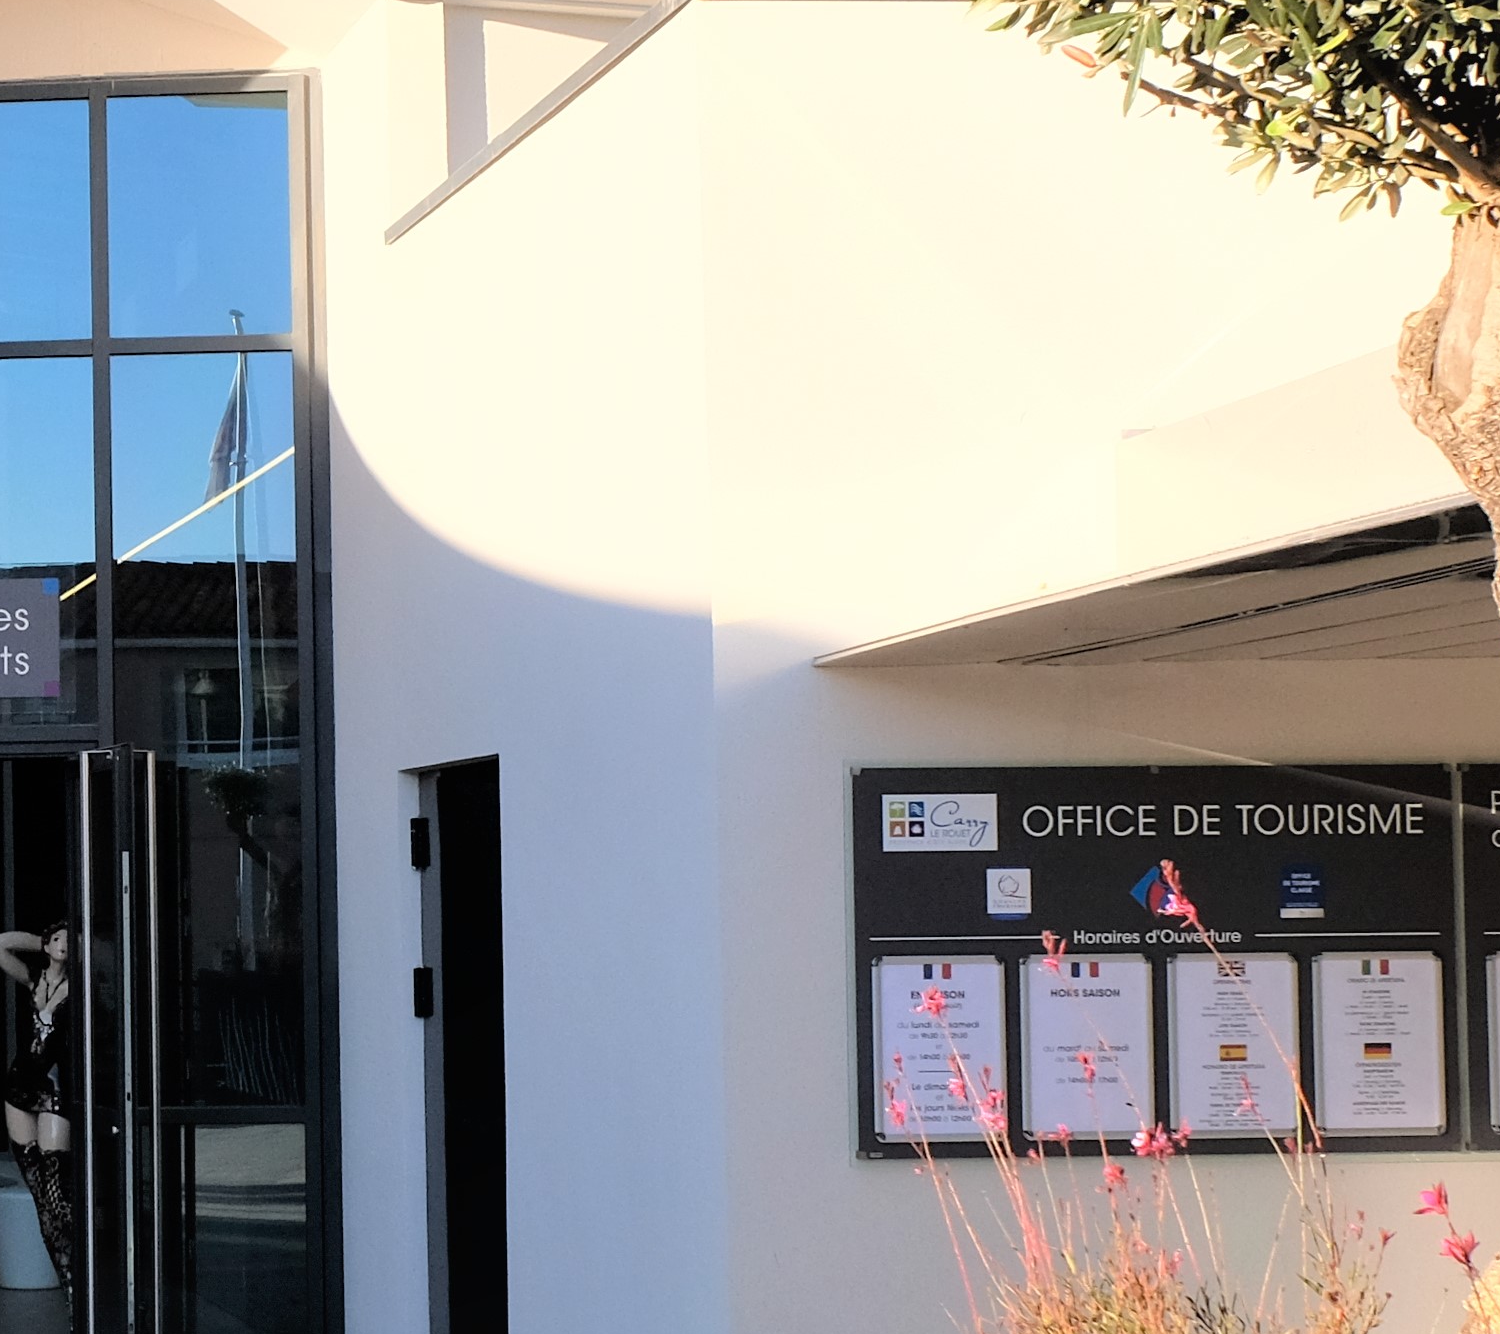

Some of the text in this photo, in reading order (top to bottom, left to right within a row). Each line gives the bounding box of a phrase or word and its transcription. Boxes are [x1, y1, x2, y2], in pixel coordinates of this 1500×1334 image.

[1021, 803, 1425, 837] OFFICE DE TOURISME
[1073, 929, 1141, 945] Horaires
[1082, 988, 1120, 998] SAISON
